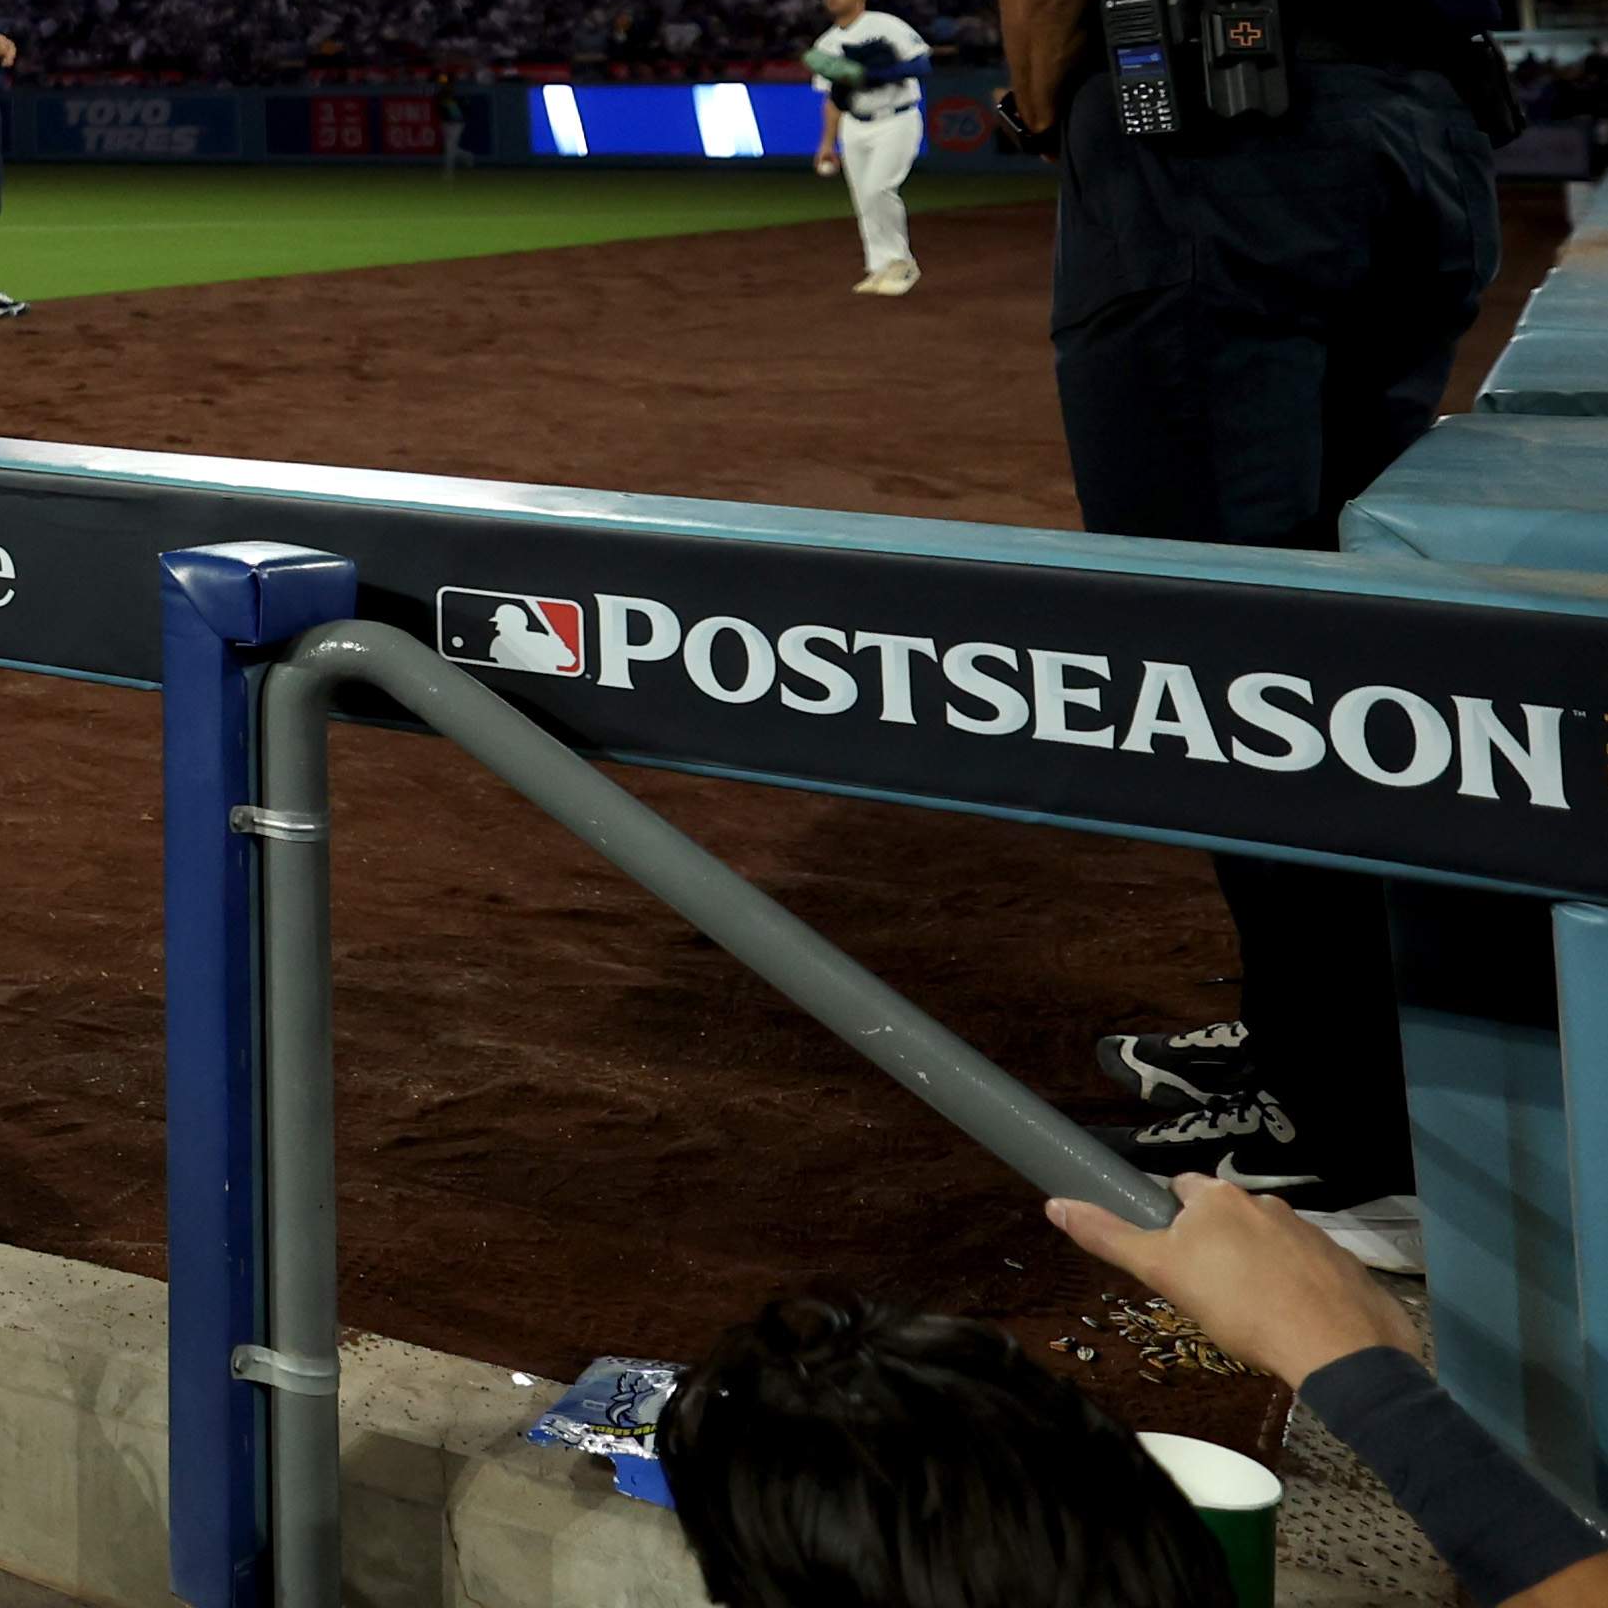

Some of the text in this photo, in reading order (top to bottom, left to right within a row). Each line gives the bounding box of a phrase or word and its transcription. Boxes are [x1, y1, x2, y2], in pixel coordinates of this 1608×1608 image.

[64, 99, 172, 126] TOYO
[81, 125, 200, 153] TIRES
[594, 594, 1570, 809] POSTSEASON
